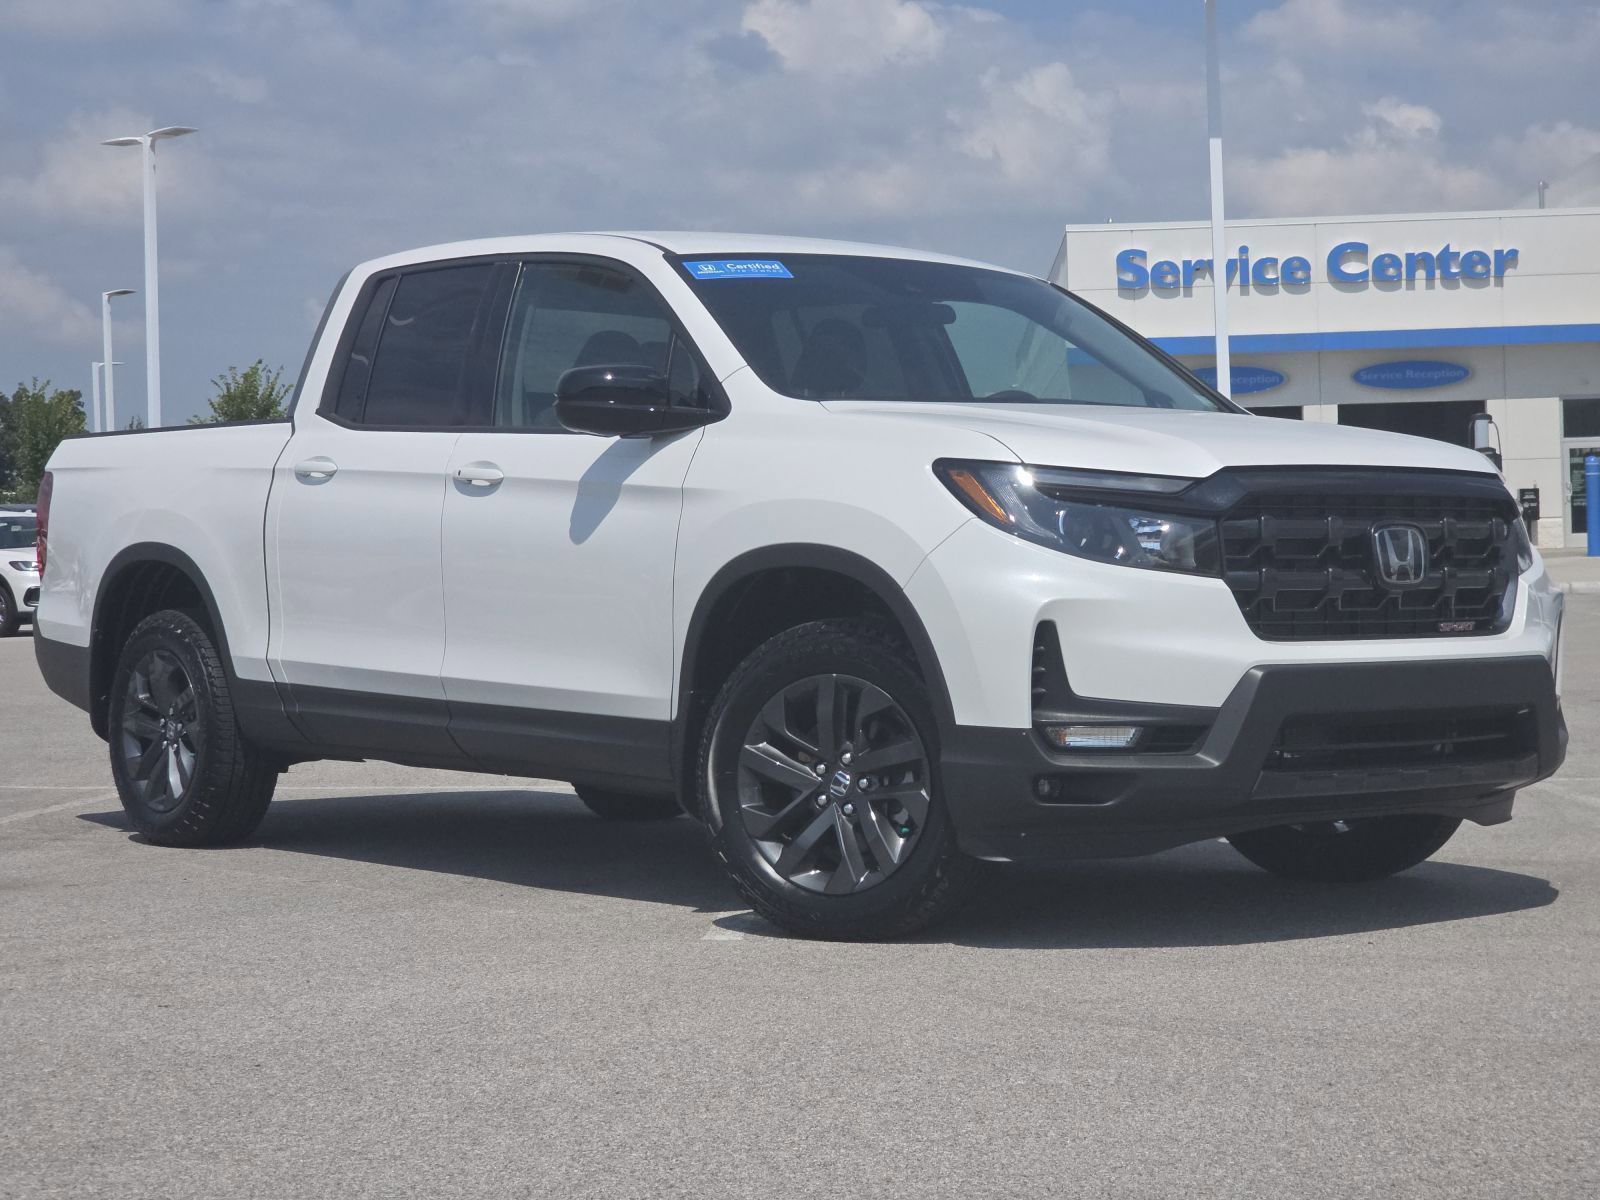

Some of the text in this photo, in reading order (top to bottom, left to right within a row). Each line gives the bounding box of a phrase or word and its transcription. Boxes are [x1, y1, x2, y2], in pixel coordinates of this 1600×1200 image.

[1326, 241, 1519, 283] Center
[1230, 374, 1280, 387] eception
[1359, 367, 1464, 381] Service Reception
